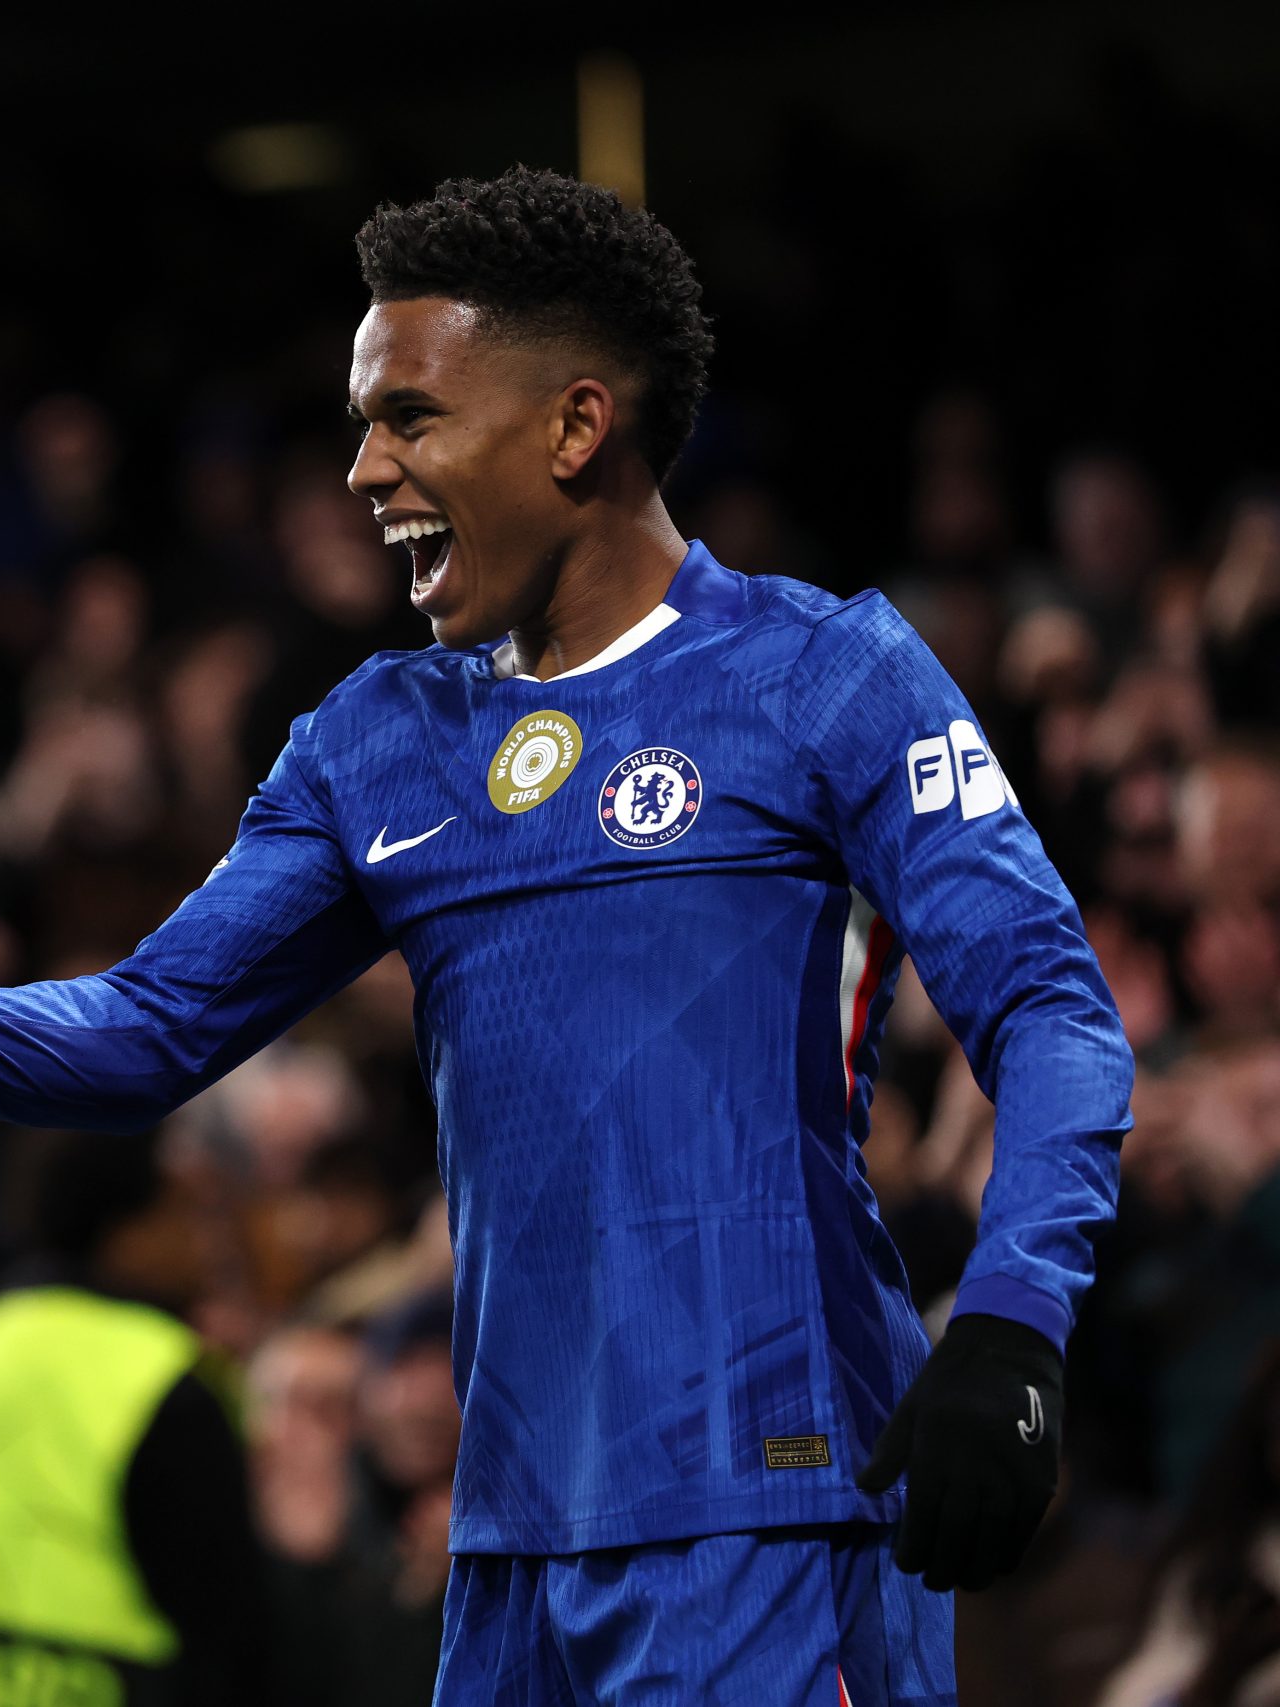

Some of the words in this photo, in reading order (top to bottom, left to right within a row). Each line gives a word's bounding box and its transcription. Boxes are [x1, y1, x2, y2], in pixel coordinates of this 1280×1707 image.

[496, 730, 525, 781] WORLD
[526, 719, 574, 769] CHAMPIONS
[619, 751, 685, 776] CHELSEA
[507, 788, 541, 806] FIFA
[612, 828, 655, 845] FOOTBALL
[659, 823, 682, 841] CLUB
